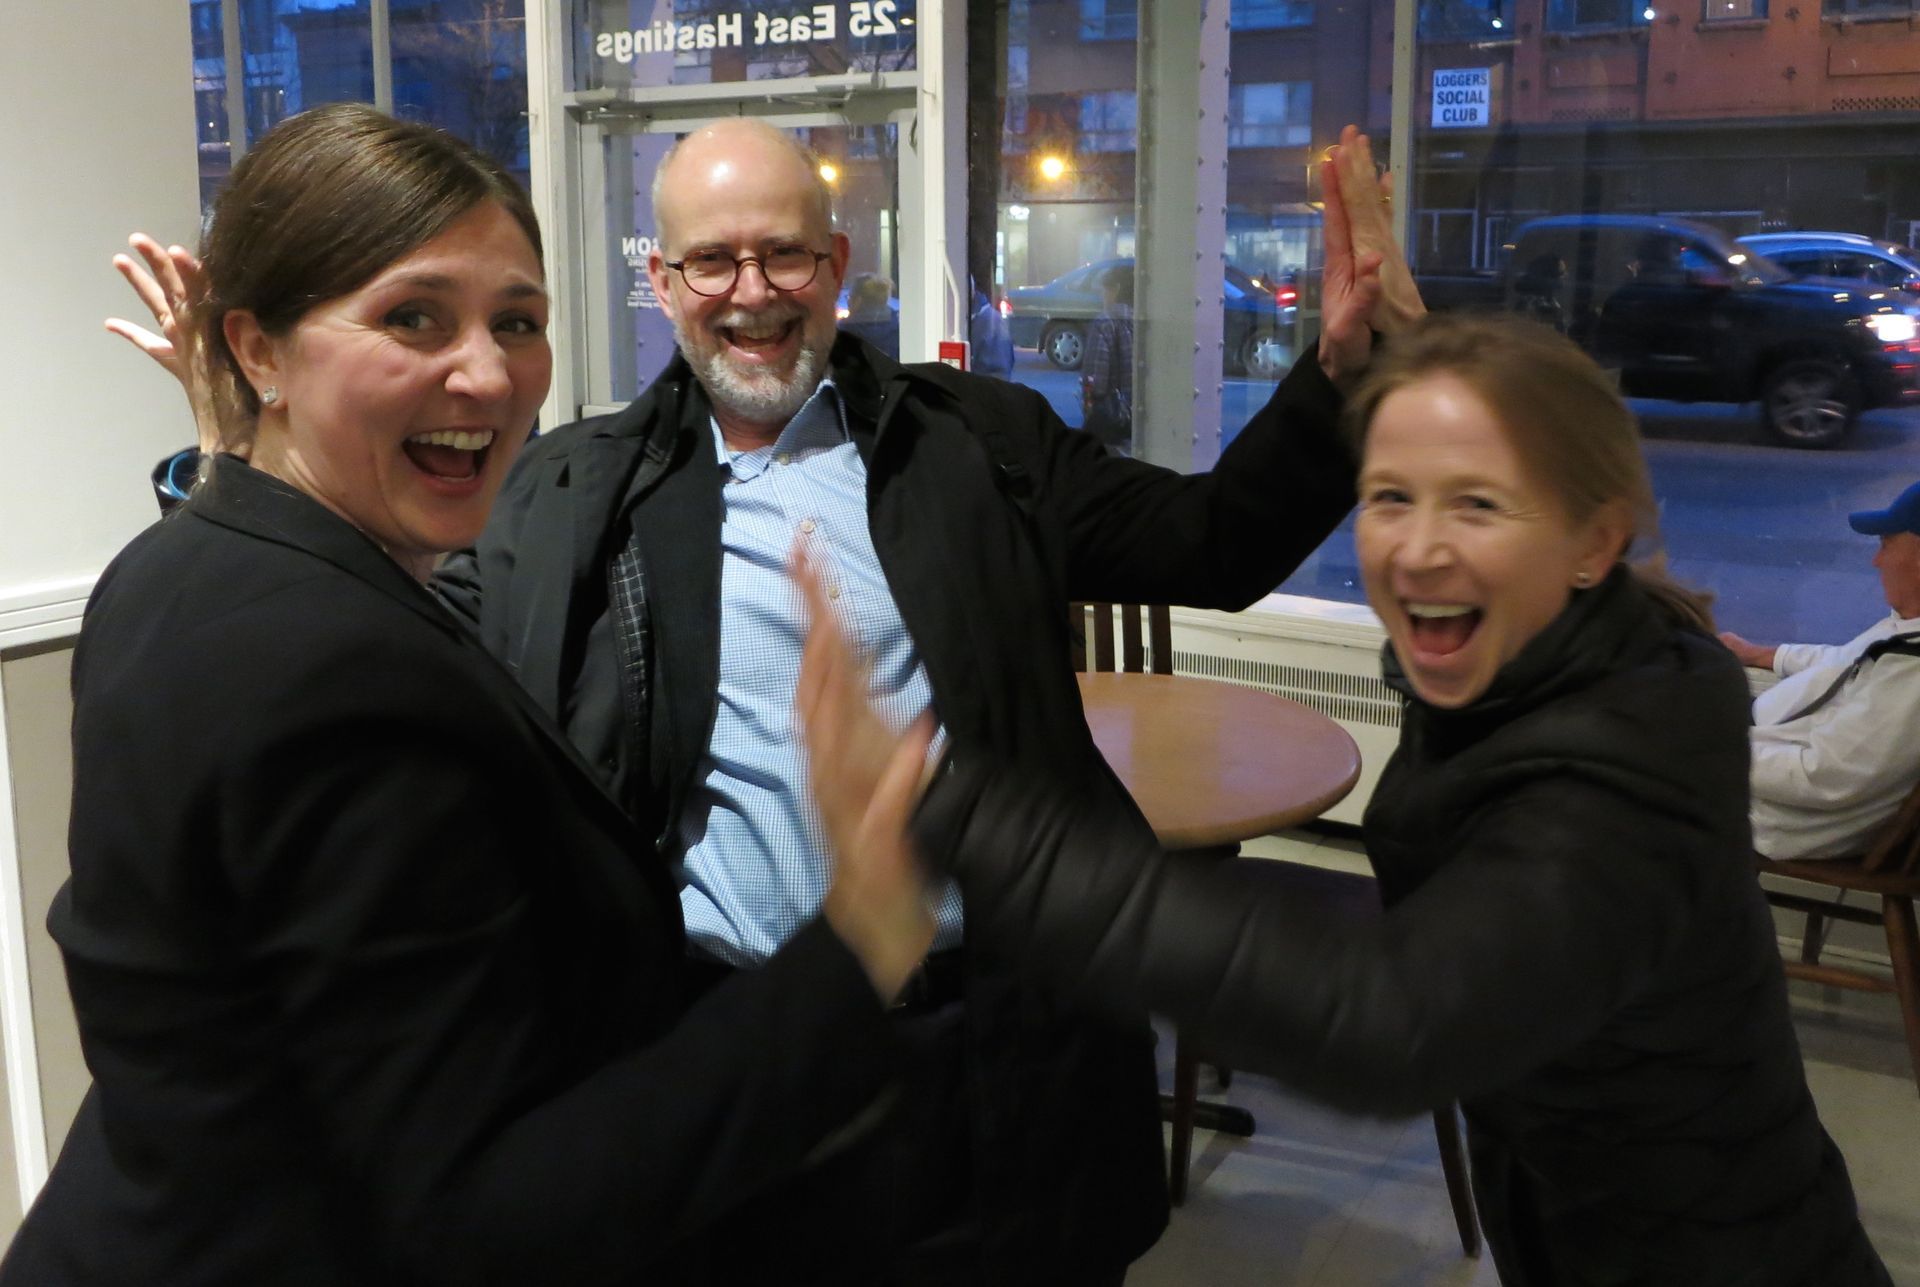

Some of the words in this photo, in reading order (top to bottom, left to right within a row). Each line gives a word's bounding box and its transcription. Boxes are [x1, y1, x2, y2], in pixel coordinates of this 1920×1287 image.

[1435, 73, 1488, 87] LOGGERS
[1436, 90, 1485, 105] SOCIAL
[1442, 108, 1478, 122] CLUB
